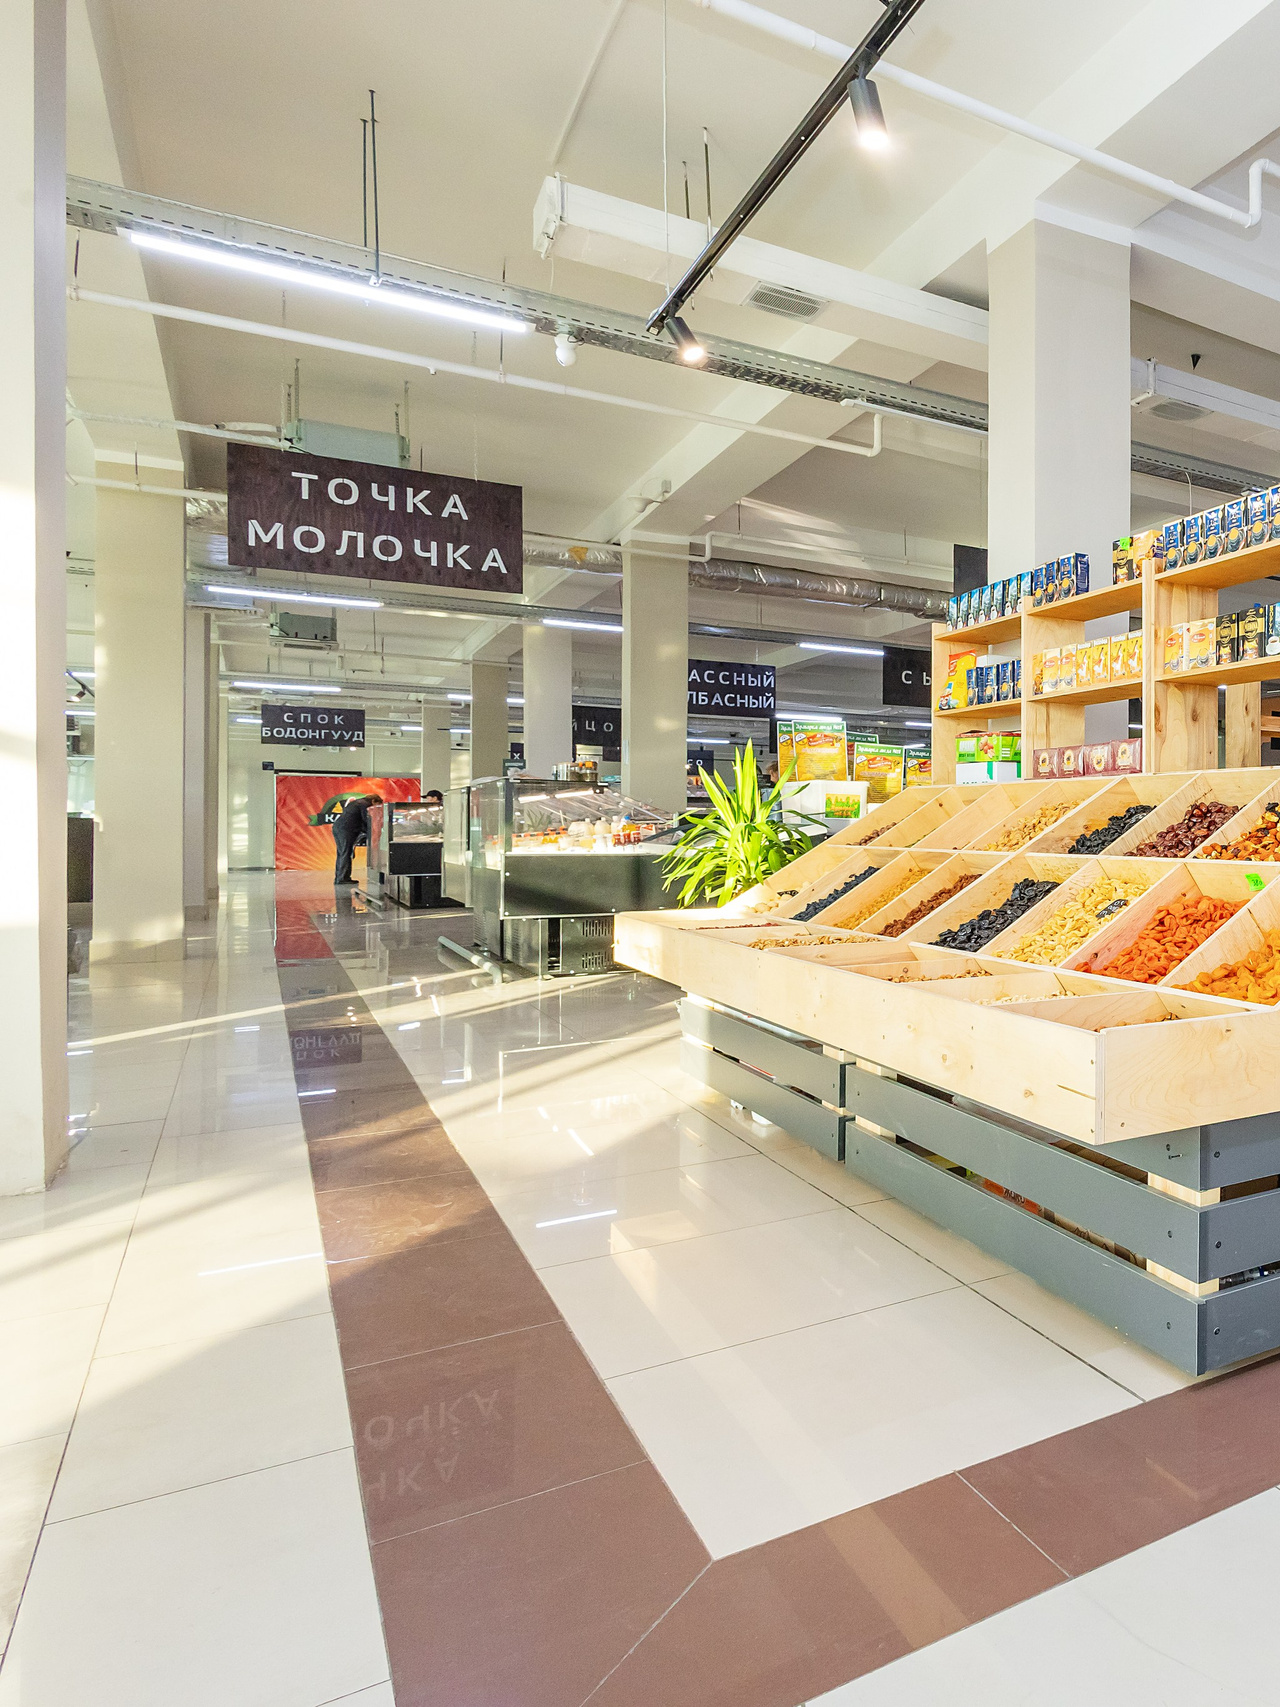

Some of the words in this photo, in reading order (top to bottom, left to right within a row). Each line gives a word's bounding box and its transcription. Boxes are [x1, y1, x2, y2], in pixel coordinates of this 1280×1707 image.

[291, 471, 469, 520] ТОЧКА
[247, 519, 508, 574] МОЛОЧКА
[262, 727, 364, 742] БОДОНГУУД
[283, 712, 345, 725] СПОК
